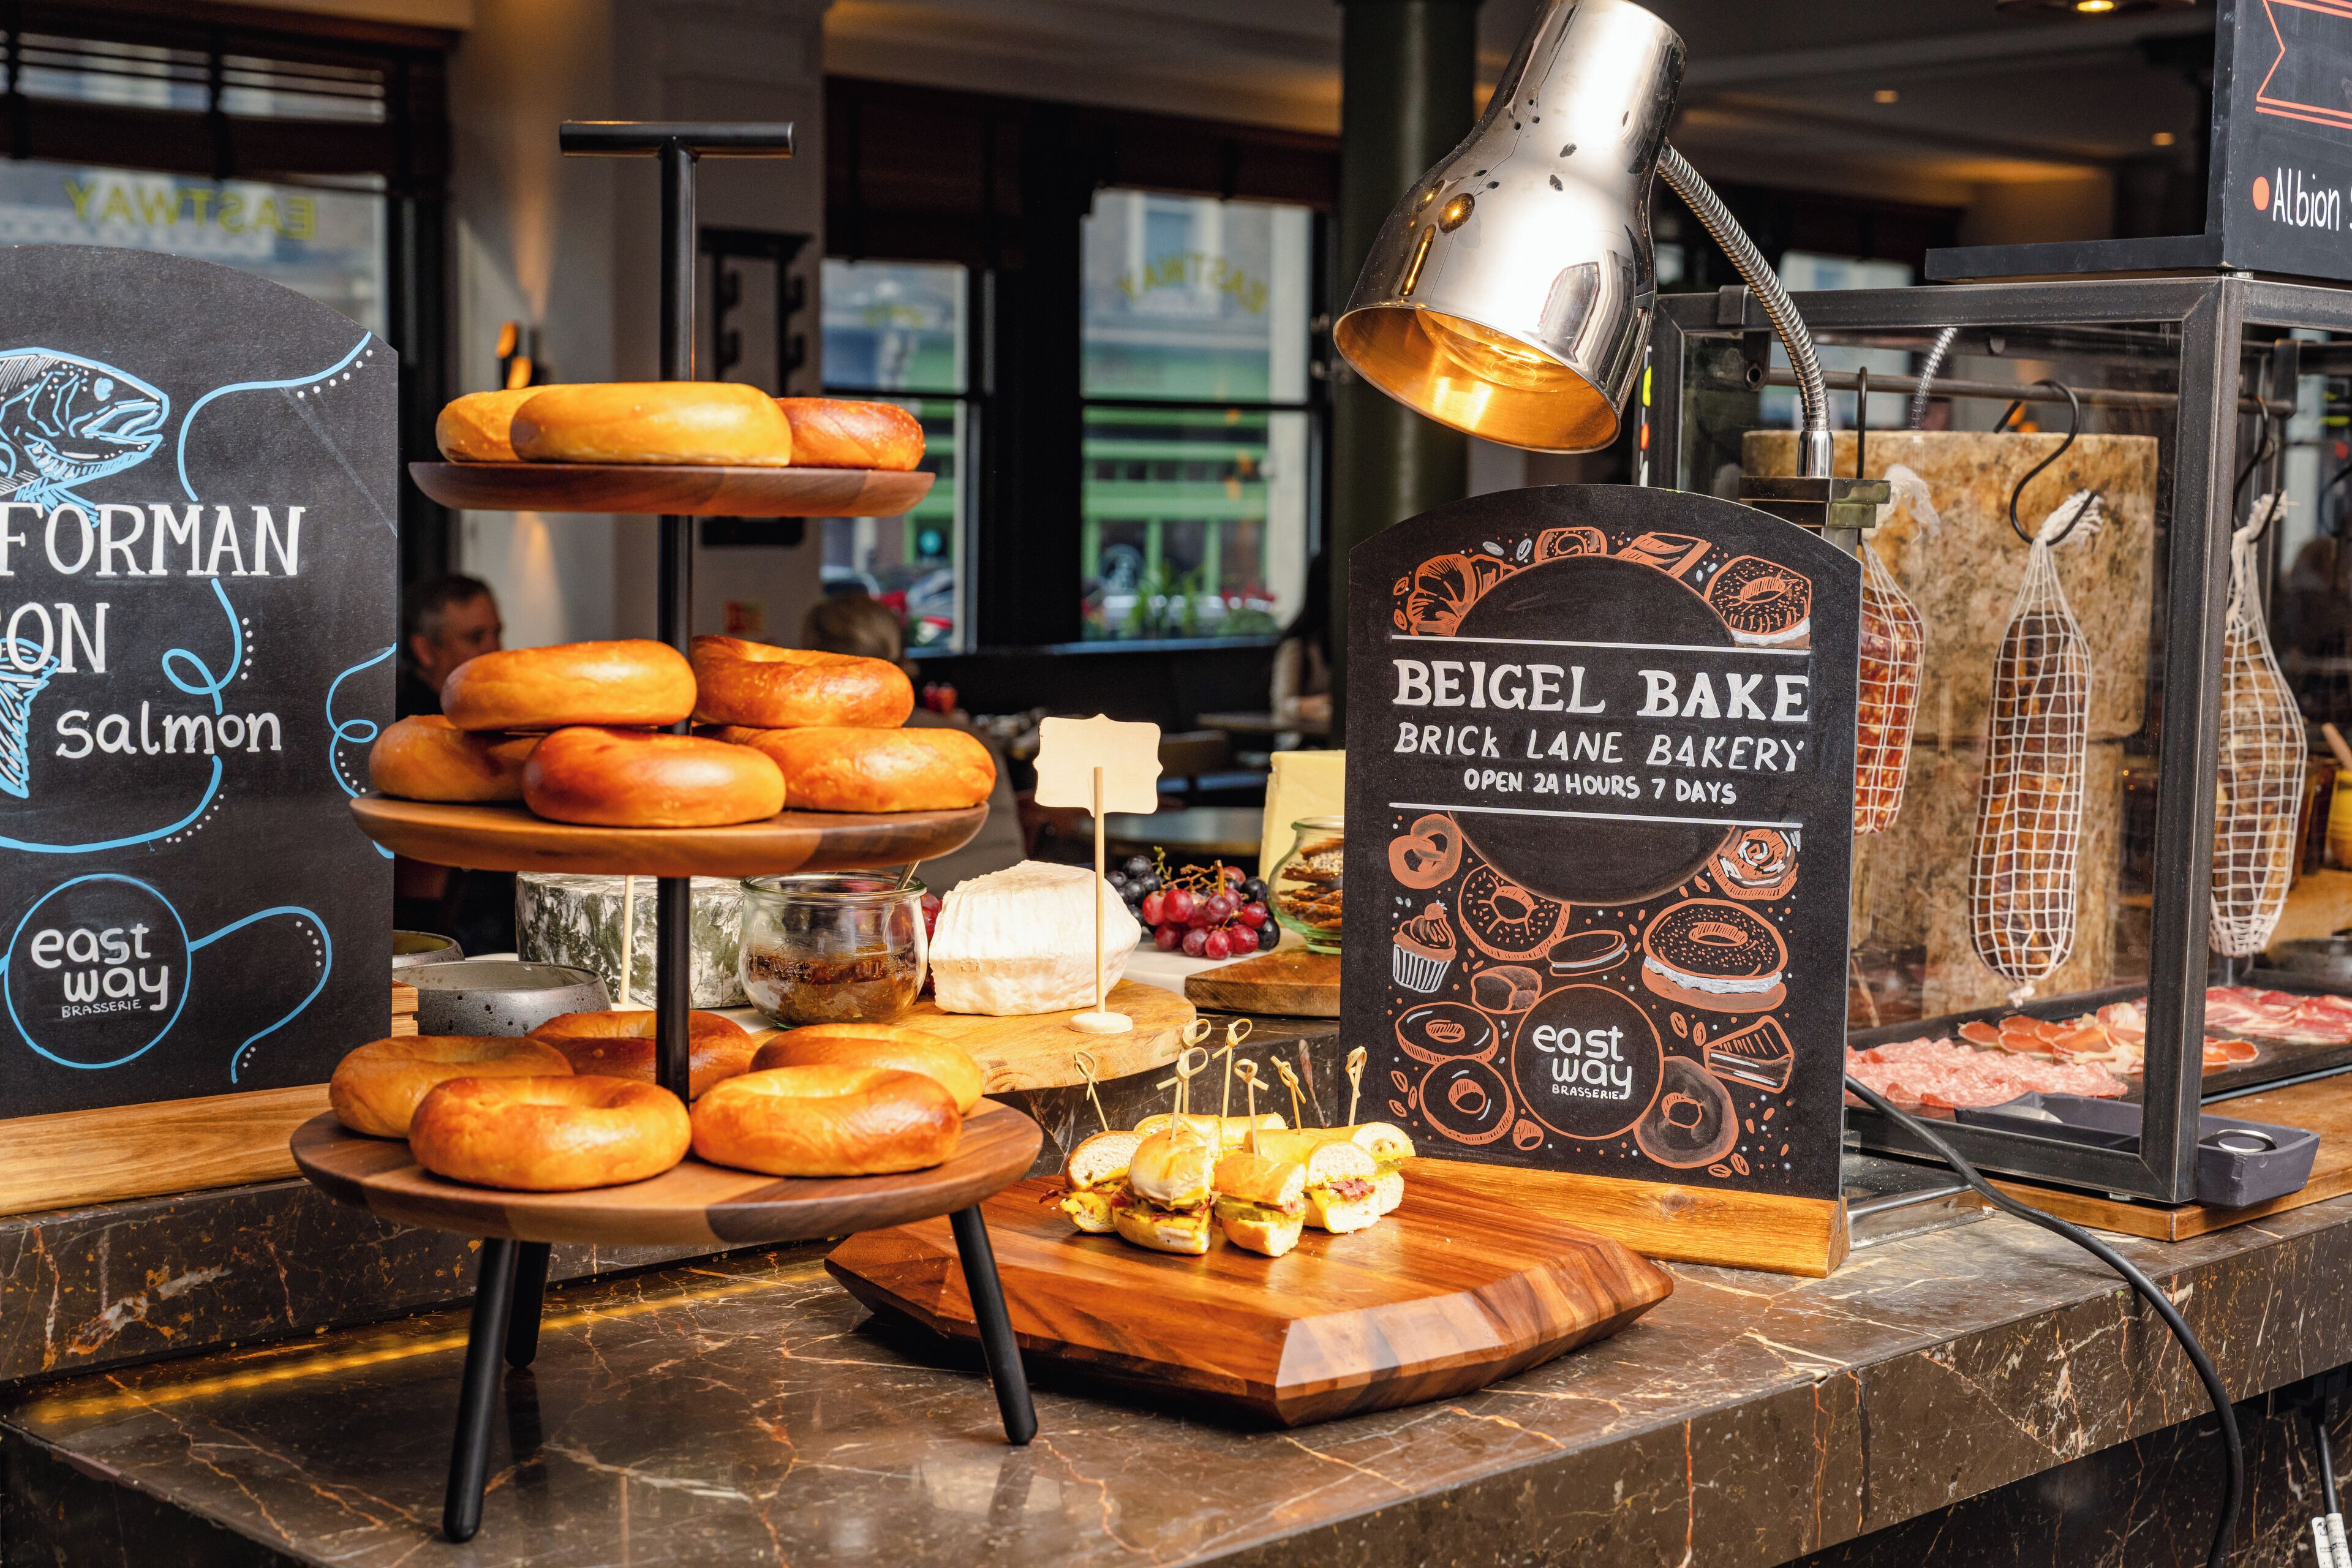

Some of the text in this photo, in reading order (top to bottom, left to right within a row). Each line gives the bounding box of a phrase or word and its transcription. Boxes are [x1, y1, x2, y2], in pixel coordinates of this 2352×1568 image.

[2273, 167, 2340, 231] Albion
[0, 502, 307, 577] FORMAN
[0, 602, 110, 674] ON
[1393, 659, 1809, 722] BEIGEL BAKE
[56, 700, 282, 759] salmon
[1527, 729, 1623, 763] LANE
[1646, 734, 1804, 772] BAKERY
[1464, 768, 1737, 804] OPEN 24 HOURS 7 DAYS
[31, 923, 151, 969] east
[61, 998, 142, 1019] BRASSERIE
[63, 965, 169, 1011] way
[1532, 1025, 1624, 1063] east
[1551, 1059, 1633, 1100] way
[1551, 1084, 1620, 1100] BRASSERIE
